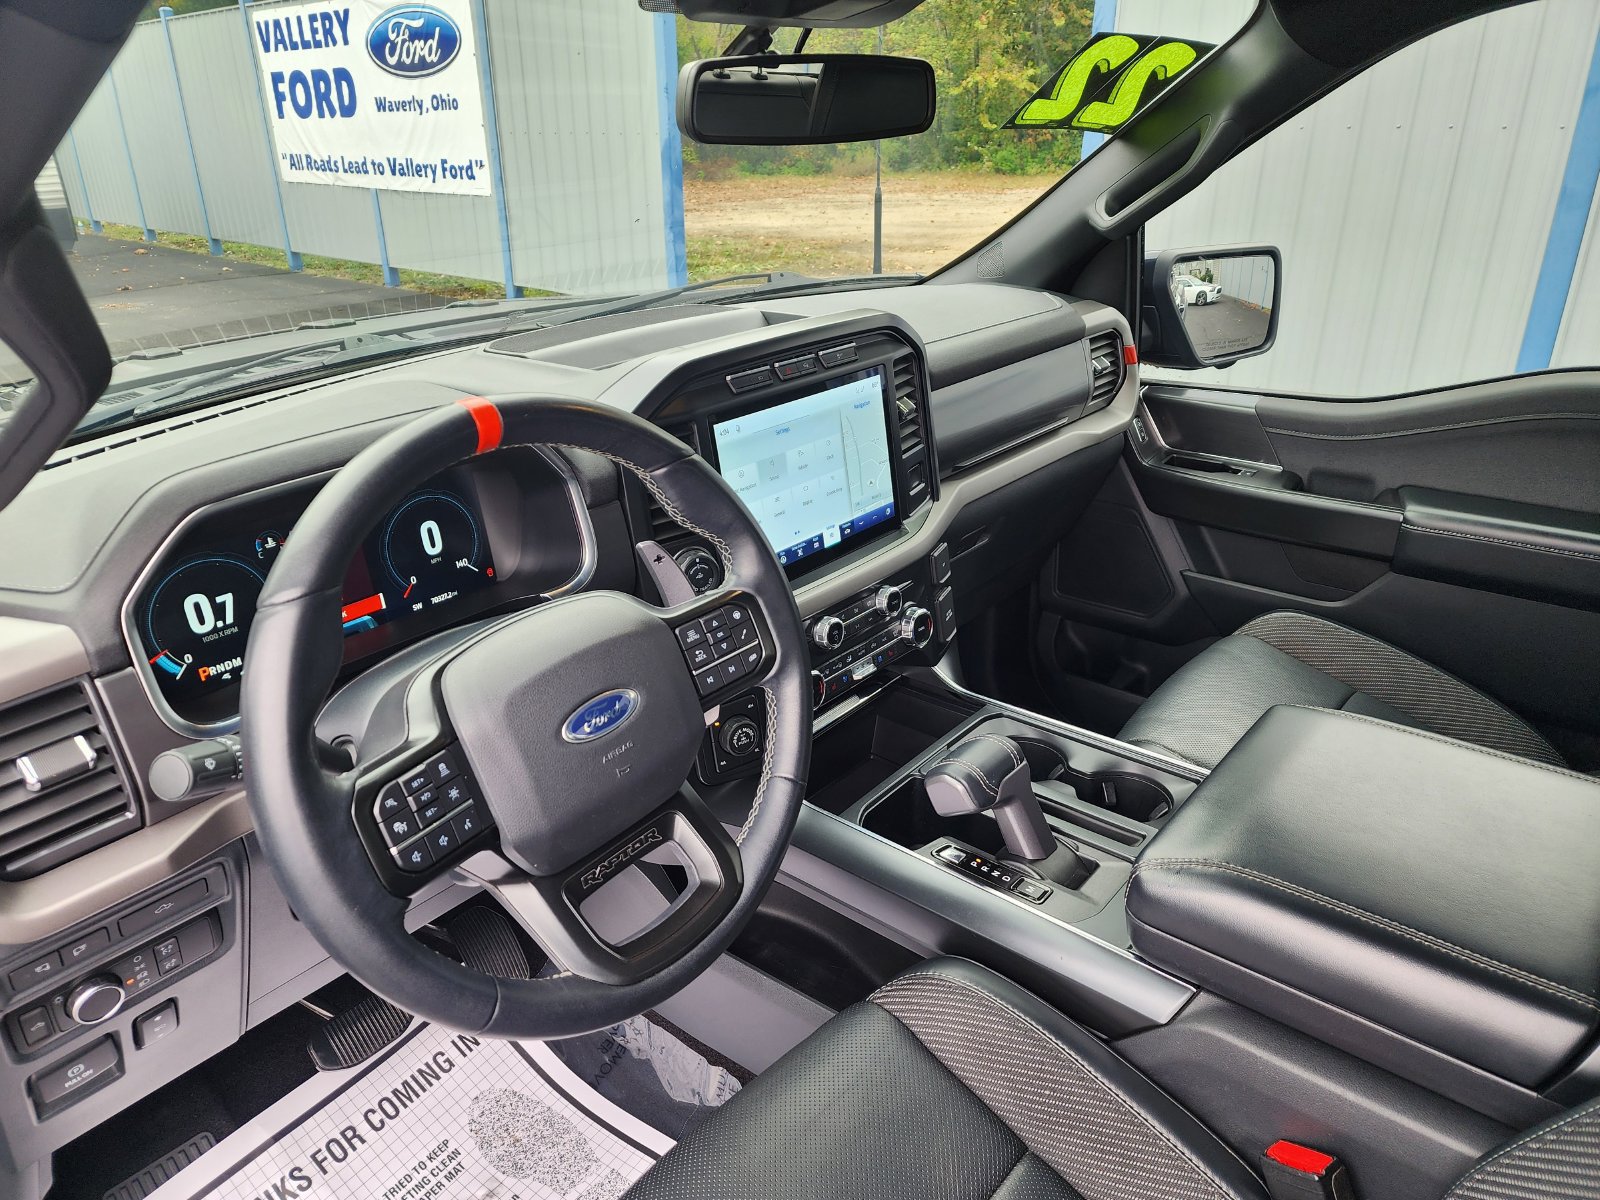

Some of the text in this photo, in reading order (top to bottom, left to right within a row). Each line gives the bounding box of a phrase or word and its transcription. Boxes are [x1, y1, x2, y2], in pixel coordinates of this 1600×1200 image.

[256, 8, 350, 53] VALLERY
[385, 17, 441, 65] Ford
[271, 67, 357, 119] FORD
[374, 93, 458, 115] Waverly, Ohio
[305, 154, 340, 173] Roads
[341, 155, 369, 175] Lead
[371, 159, 385, 176] to
[386, 157, 438, 183] Vallery
[420, 520, 443, 556] 0
[455, 558, 468, 569] 140
[410, 576, 417, 584] 0
[183, 592, 234, 635] 0.7
[412, 602, 423, 611] SW
[224, 626, 239, 636] RPM
[184, 653, 194, 664] 0
[583, 700, 624, 734] Ford
[602, 740, 634, 764] AIRBAG
[580, 827, 663, 889] RAPTOR
[65, 1069, 93, 1088] PULL ON
[310, 1125, 367, 1176] FOR
[363, 1050, 456, 1132] COMING
[382, 1138, 450, 1200] TRIED TO KEEP
[430, 1147, 462, 1177] CLEAN
[444, 1161, 466, 1183] MAT
